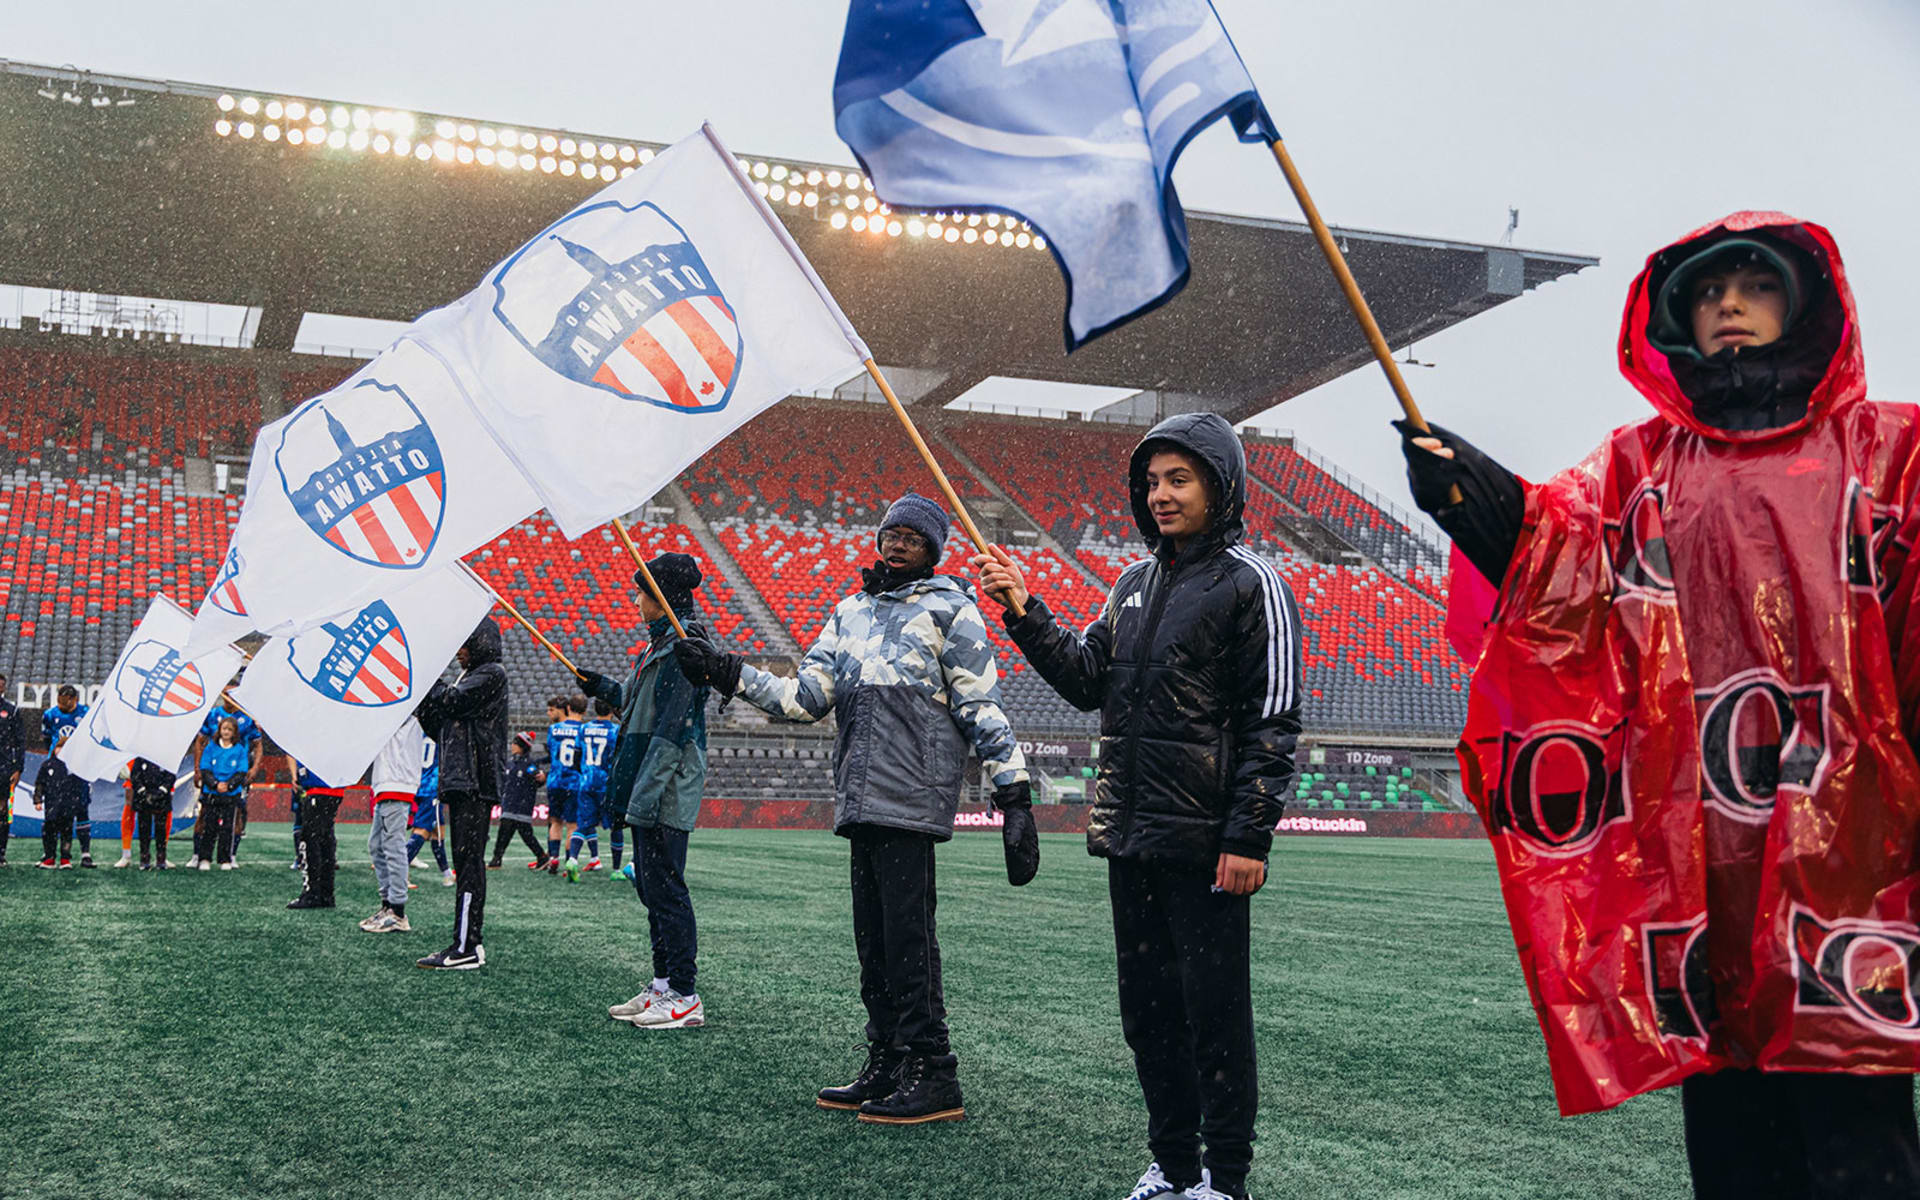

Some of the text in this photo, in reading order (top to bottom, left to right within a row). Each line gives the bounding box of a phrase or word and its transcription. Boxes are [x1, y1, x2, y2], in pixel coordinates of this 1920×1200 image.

[560, 738, 576, 767] 6
[584, 737, 607, 766] 17
[1035, 743, 1069, 755] Zone
[1346, 752, 1393, 764] TD Zone
